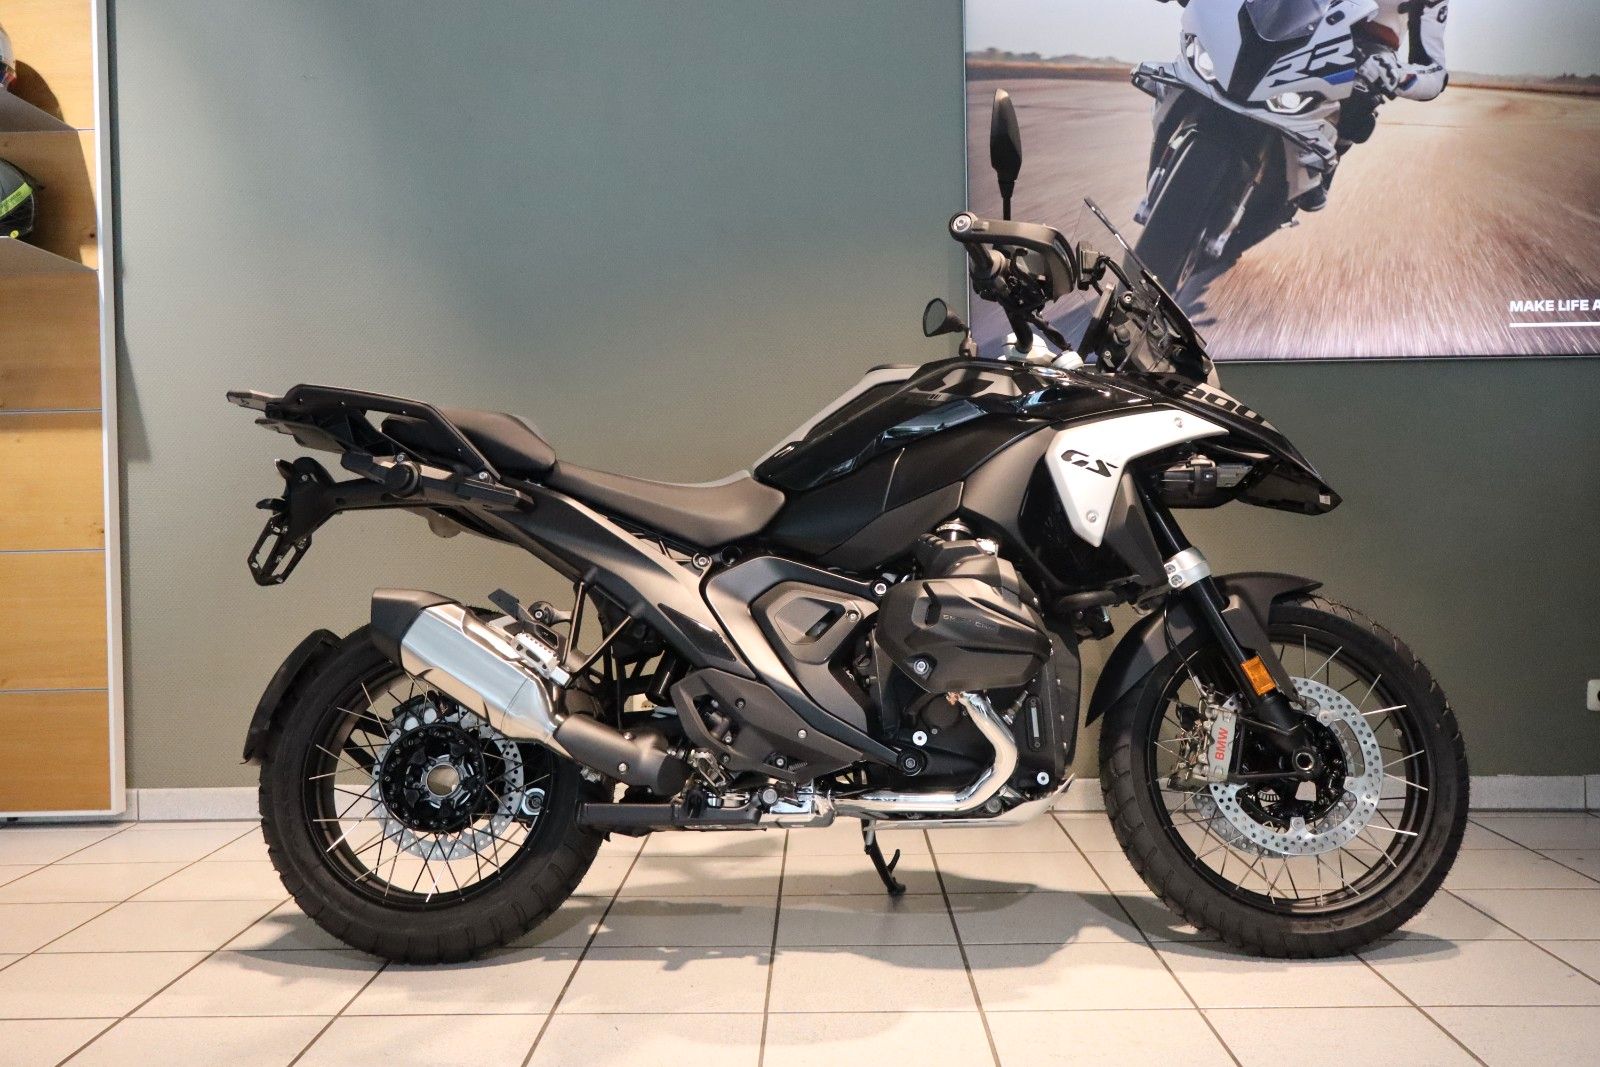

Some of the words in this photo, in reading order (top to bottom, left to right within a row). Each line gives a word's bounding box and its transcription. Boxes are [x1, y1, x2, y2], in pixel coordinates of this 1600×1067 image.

[1509, 300, 1555, 312] MAKE
[1558, 299, 1590, 312] LIFE
[1061, 449, 1119, 478] GS
[1215, 727, 1229, 761] BMW
